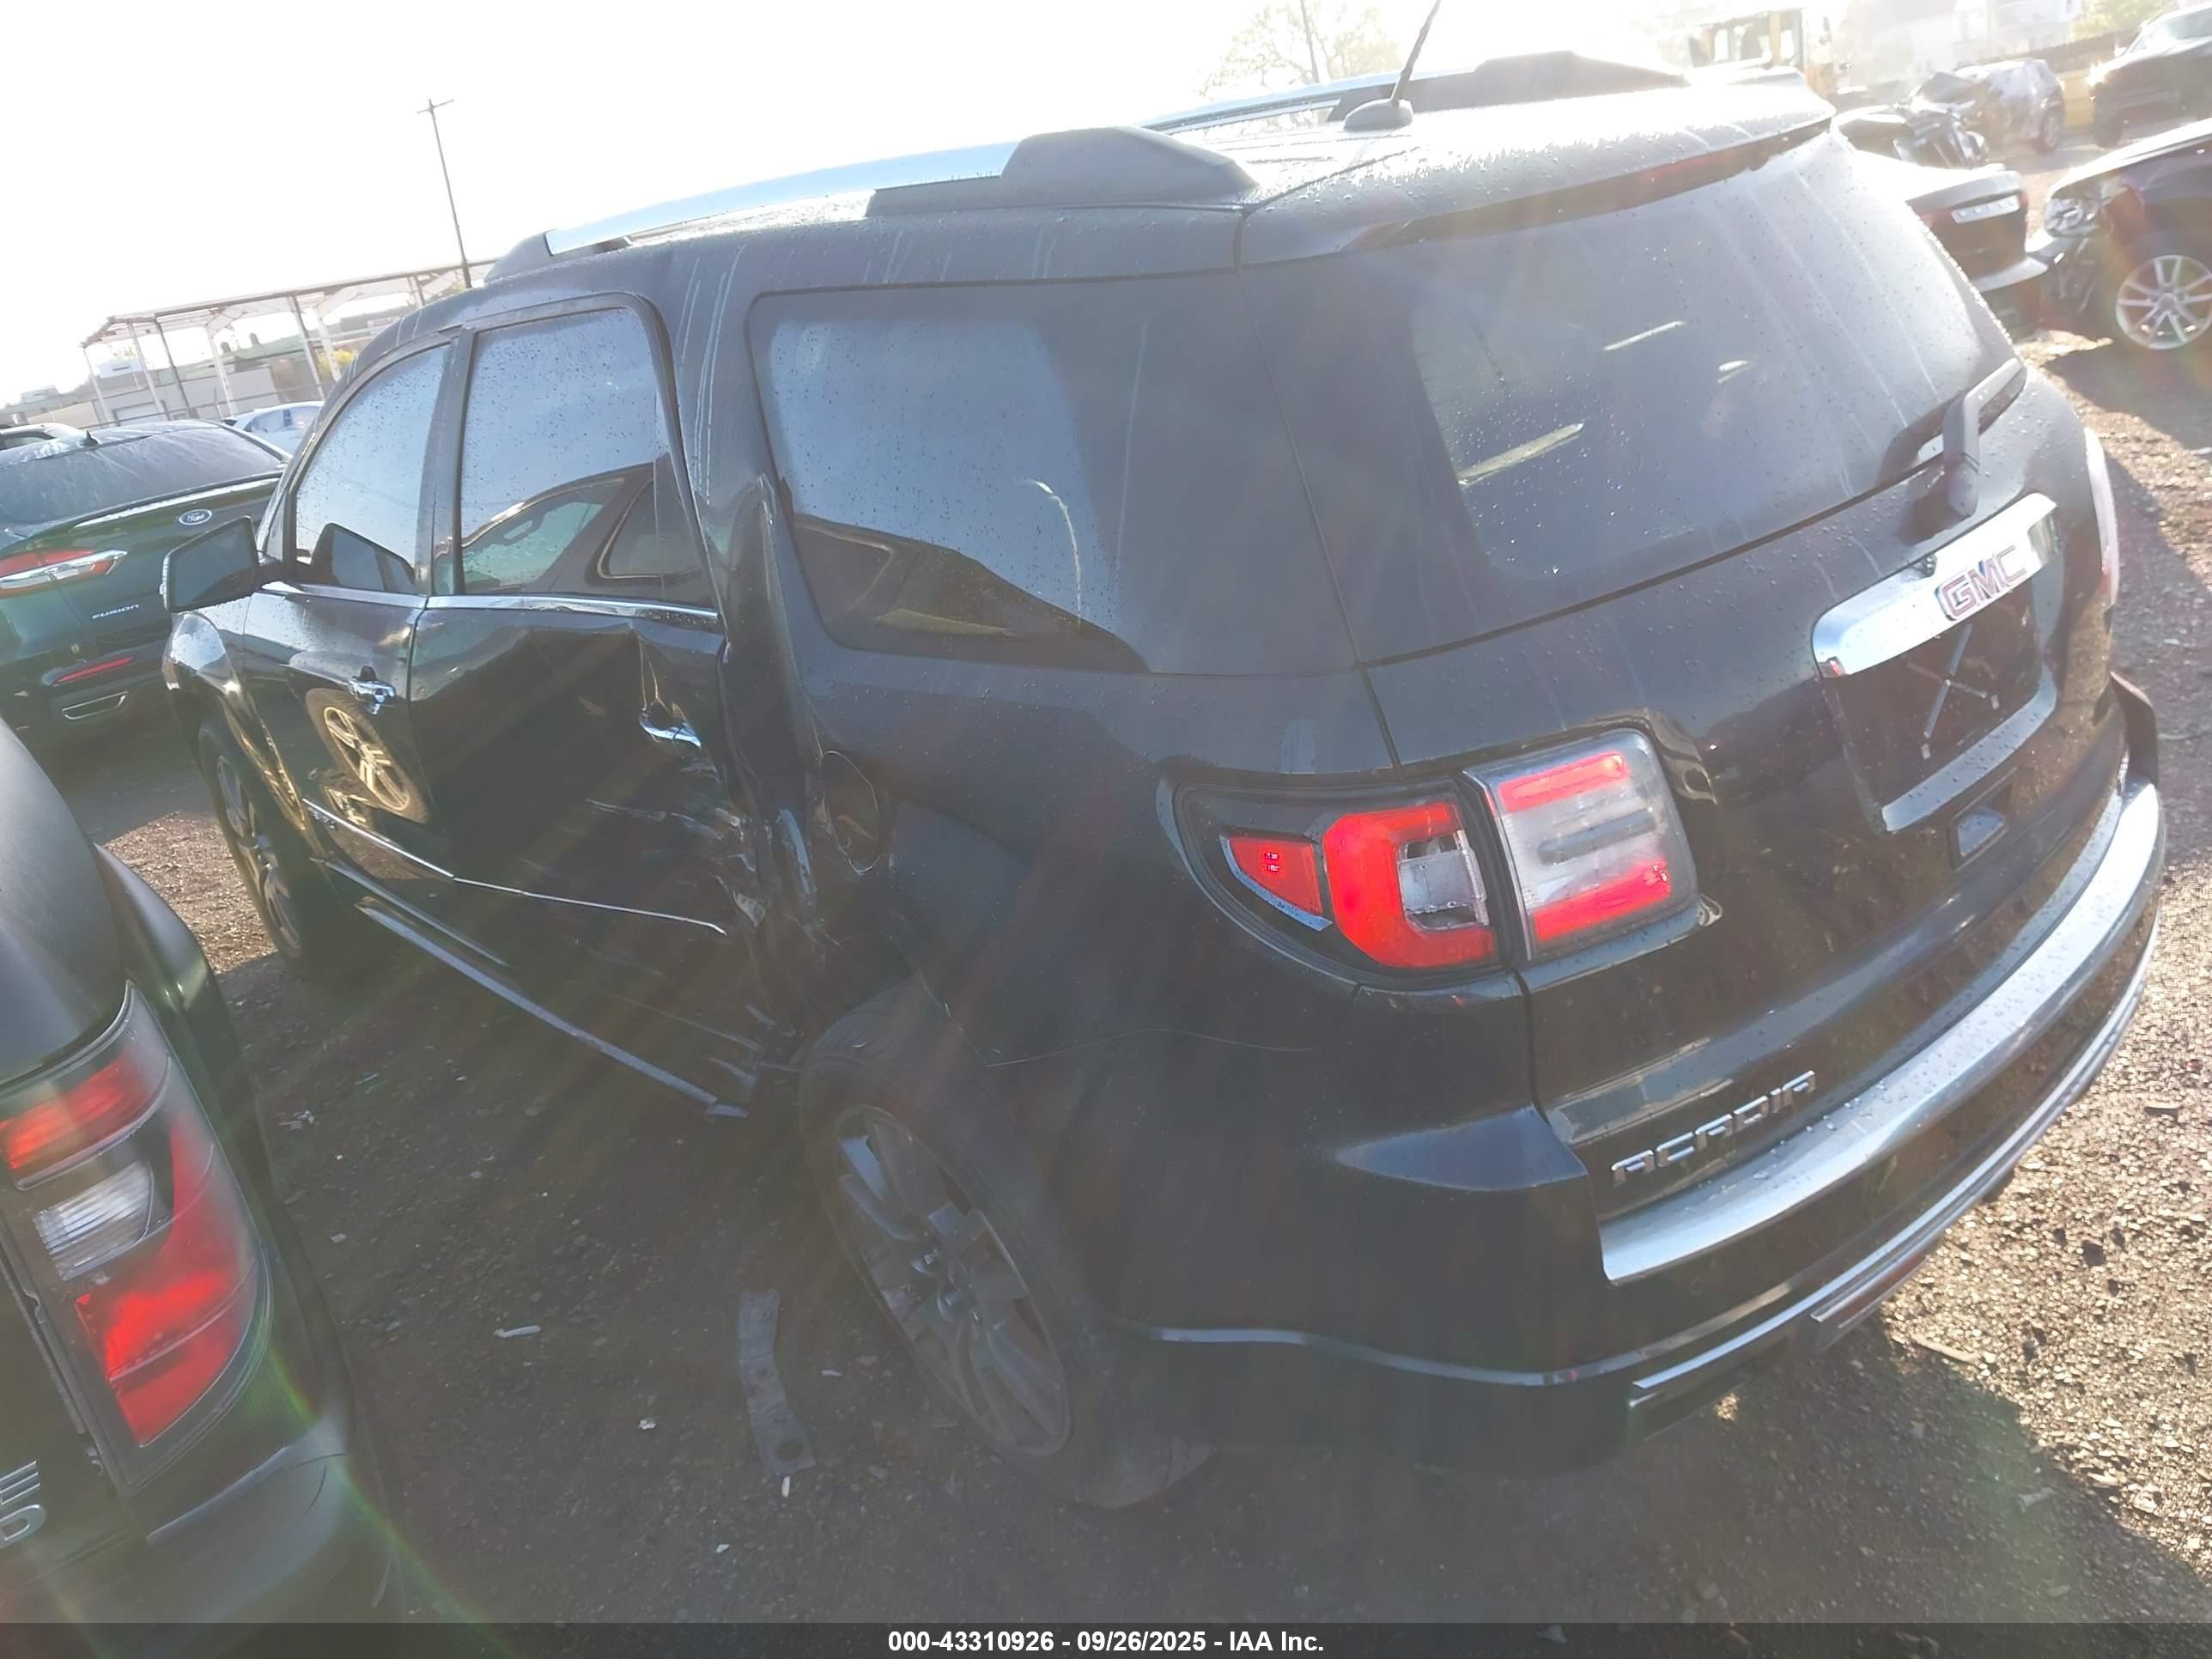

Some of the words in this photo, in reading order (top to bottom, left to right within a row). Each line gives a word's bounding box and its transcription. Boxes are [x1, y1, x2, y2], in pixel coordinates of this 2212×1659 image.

[92, 604, 140, 619] FUSION
[1935, 544, 2027, 620] GMC
[1611, 1070, 1816, 1187] ACADIA
